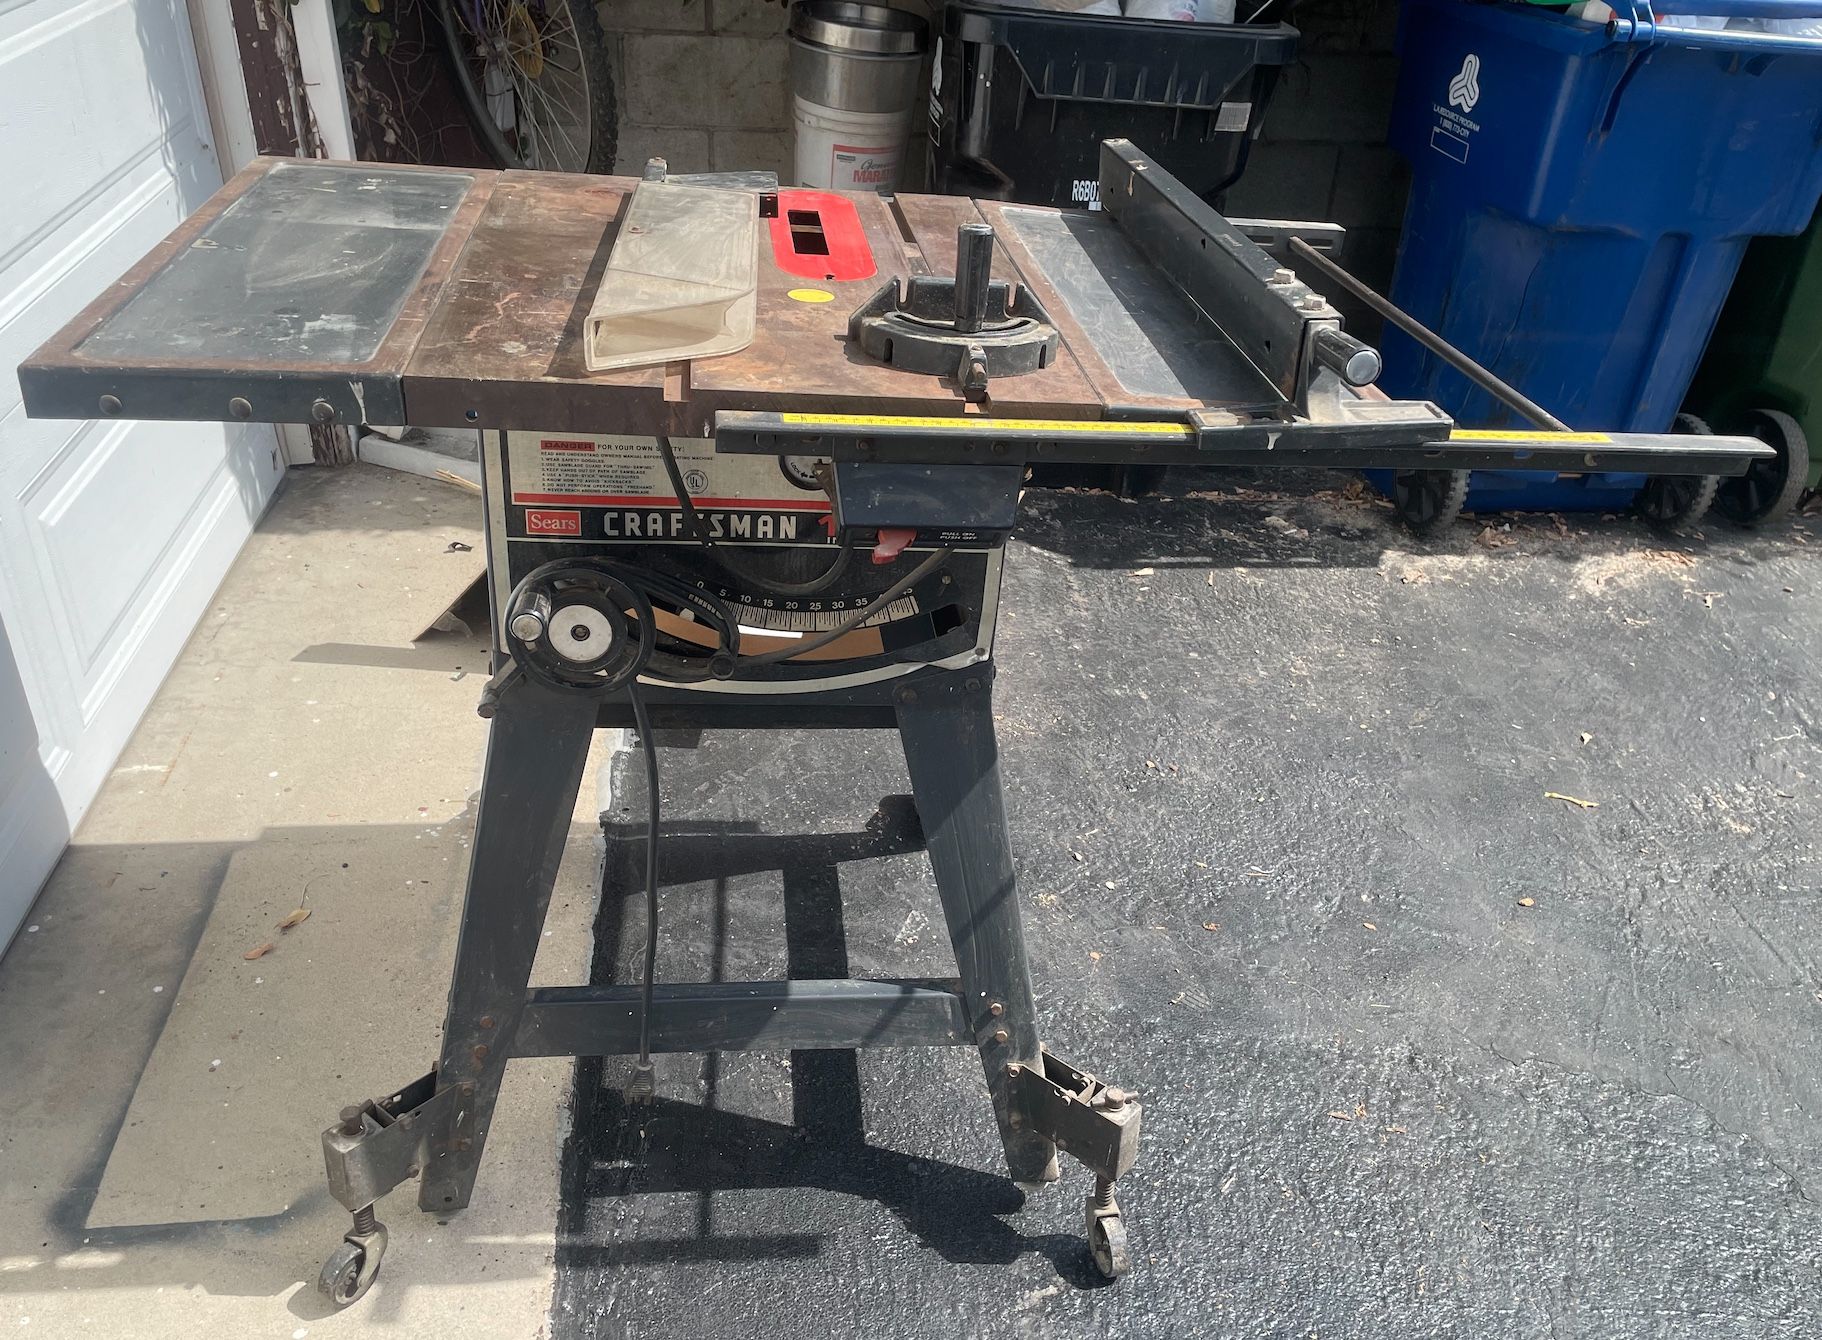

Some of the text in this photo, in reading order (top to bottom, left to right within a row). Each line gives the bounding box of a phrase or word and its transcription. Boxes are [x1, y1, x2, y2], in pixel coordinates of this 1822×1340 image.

[545, 442, 592, 450] DANGER
[790, 462, 801, 474] LOCK
[530, 513, 577, 530] Sears
[719, 588, 726, 597] 5
[740, 594, 752, 604] 10
[763, 599, 774, 607] 15
[786, 601, 798, 609] 20
[809, 602, 822, 611] 25
[832, 600, 845, 608] 30
[855, 597, 868, 606] 35
